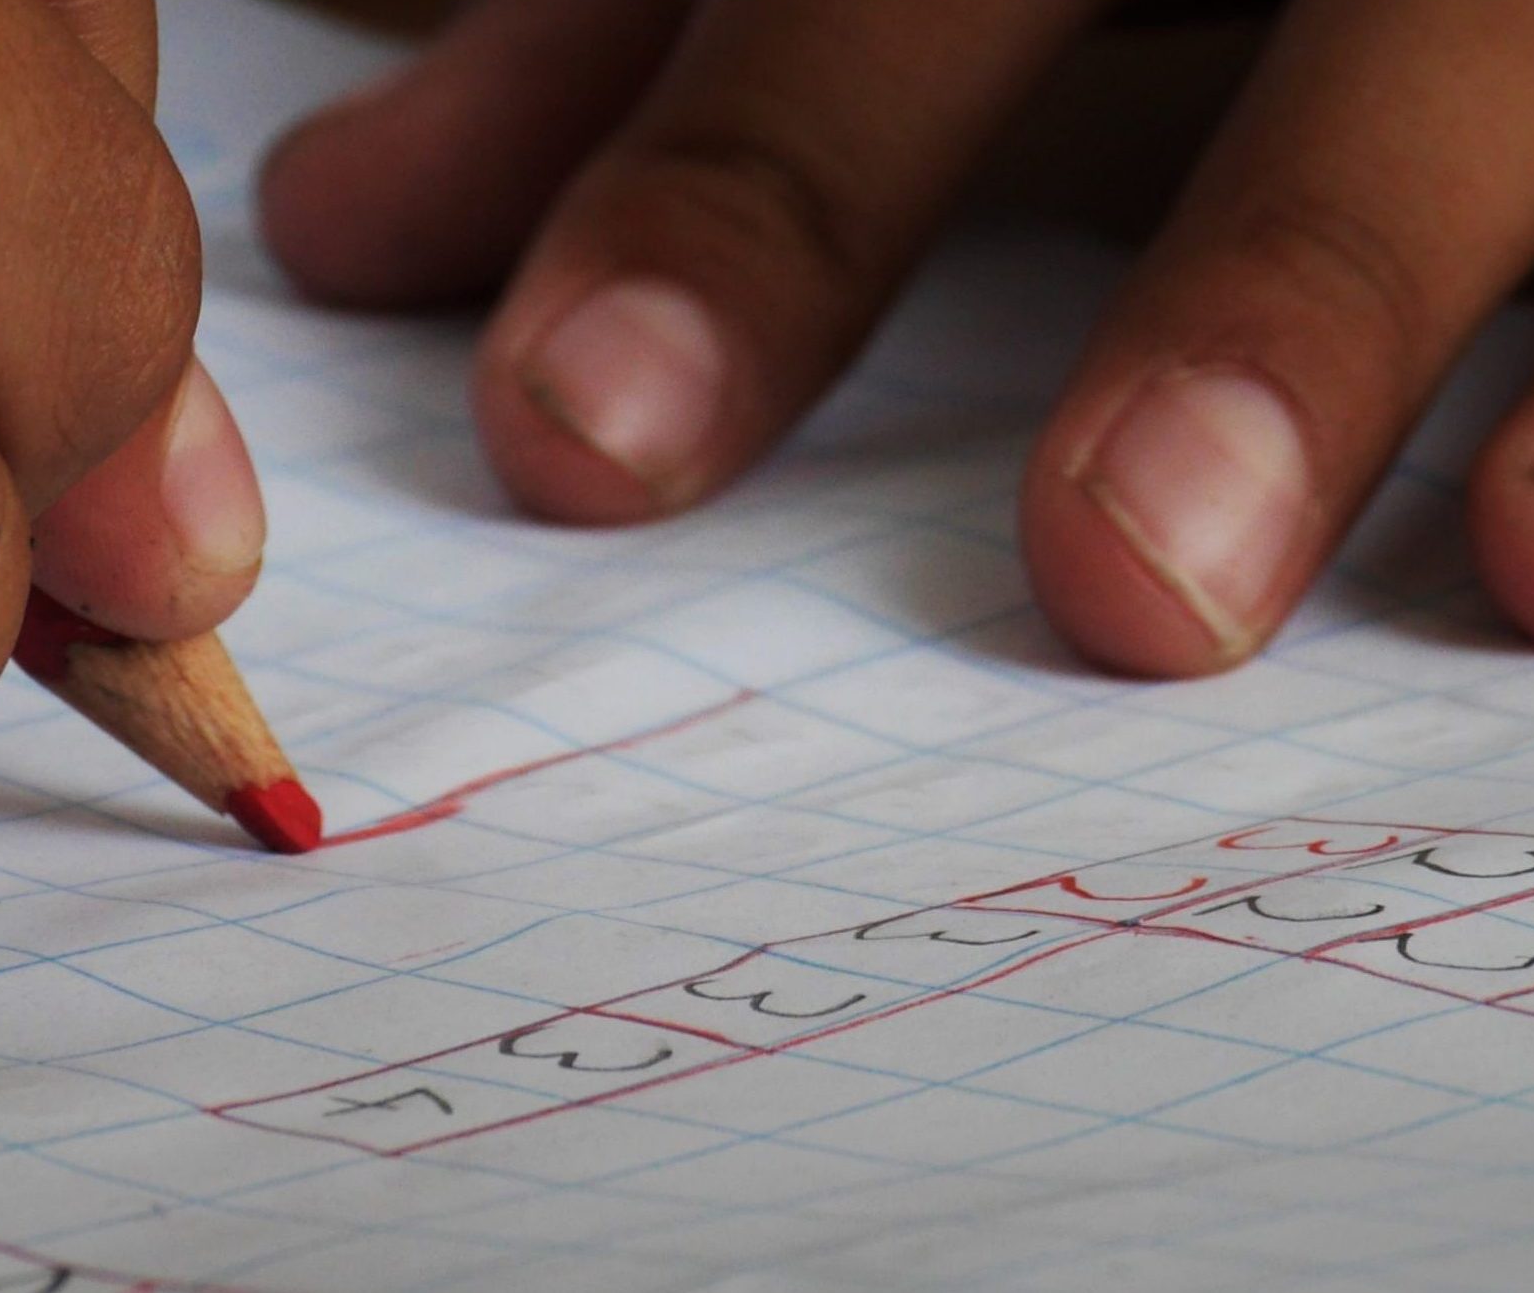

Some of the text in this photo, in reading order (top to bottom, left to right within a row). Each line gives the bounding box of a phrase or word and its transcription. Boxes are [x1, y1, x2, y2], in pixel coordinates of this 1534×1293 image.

[1216, 826, 1400, 857] 3
[1196, 895, 1386, 924] 2
[680, 917, 1041, 1020] 3 3
[497, 1023, 674, 1073] 3
